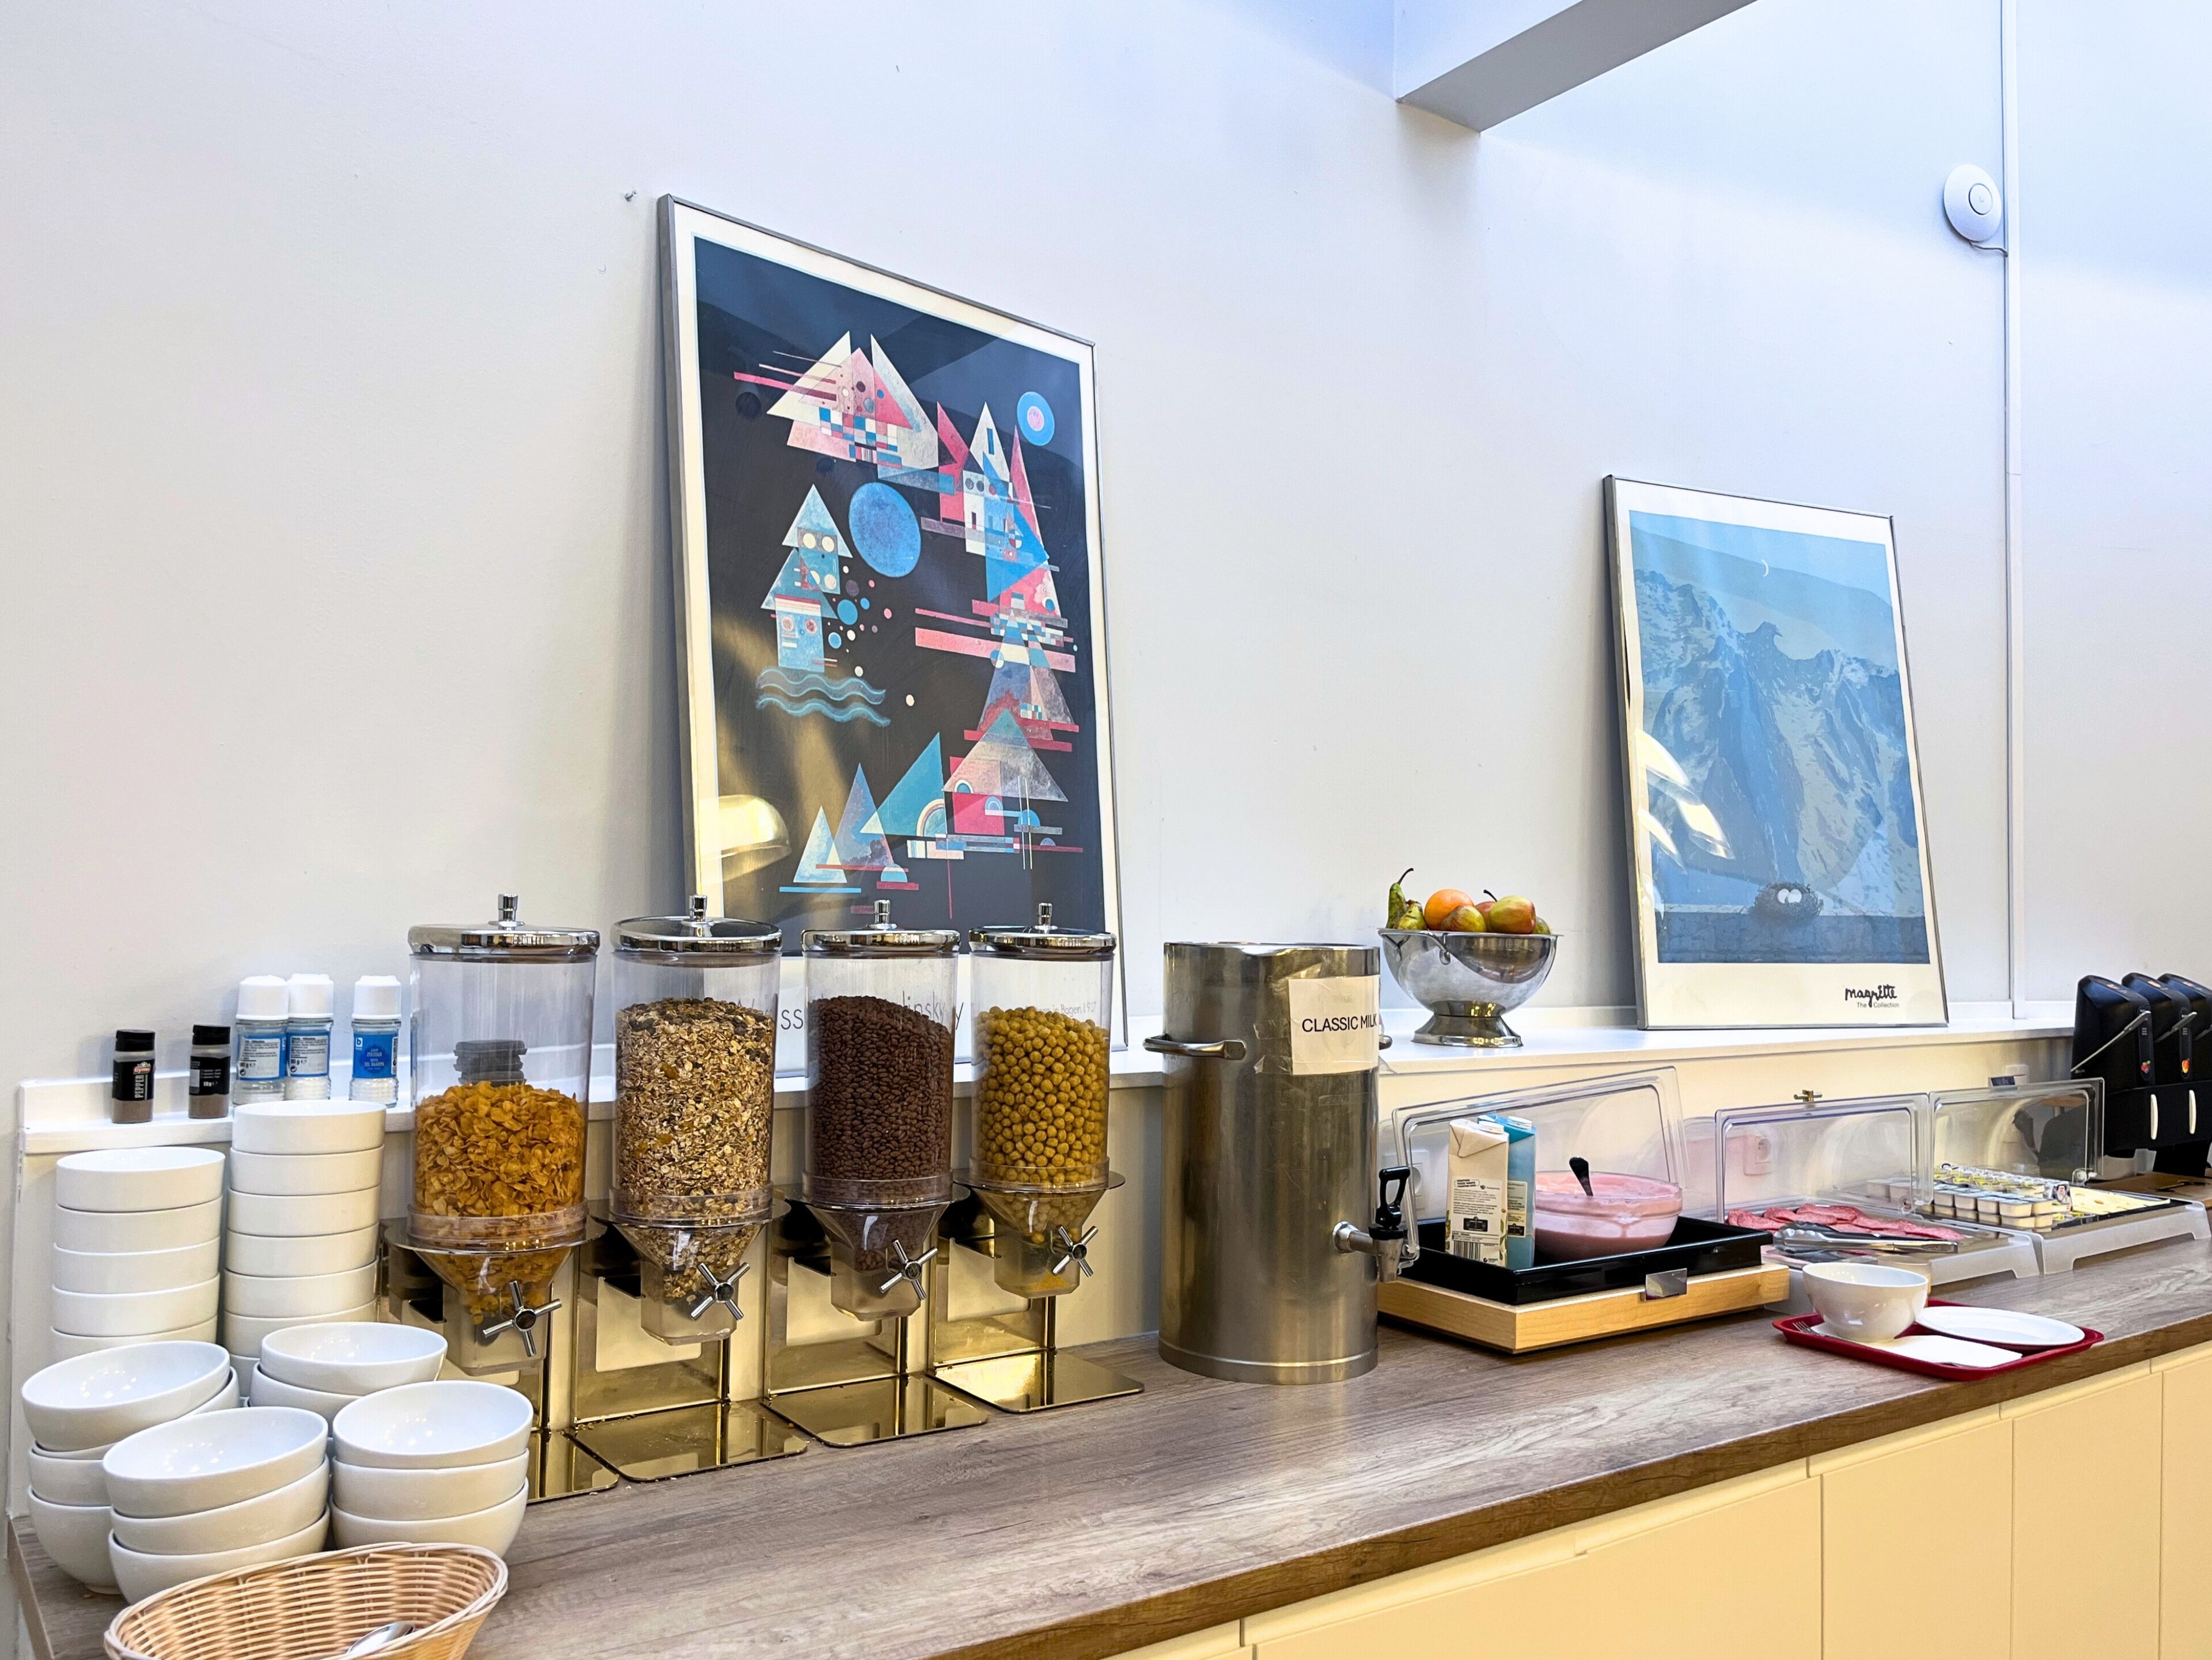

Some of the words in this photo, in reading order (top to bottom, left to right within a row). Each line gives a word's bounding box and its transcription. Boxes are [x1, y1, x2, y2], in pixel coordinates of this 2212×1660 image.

[1845, 984, 1897, 1008] magritte
[1302, 1016, 1358, 1032] CLASSIC
[1361, 1013, 1377, 1029] MILK
[135, 1075, 145, 1098] PEPPER
